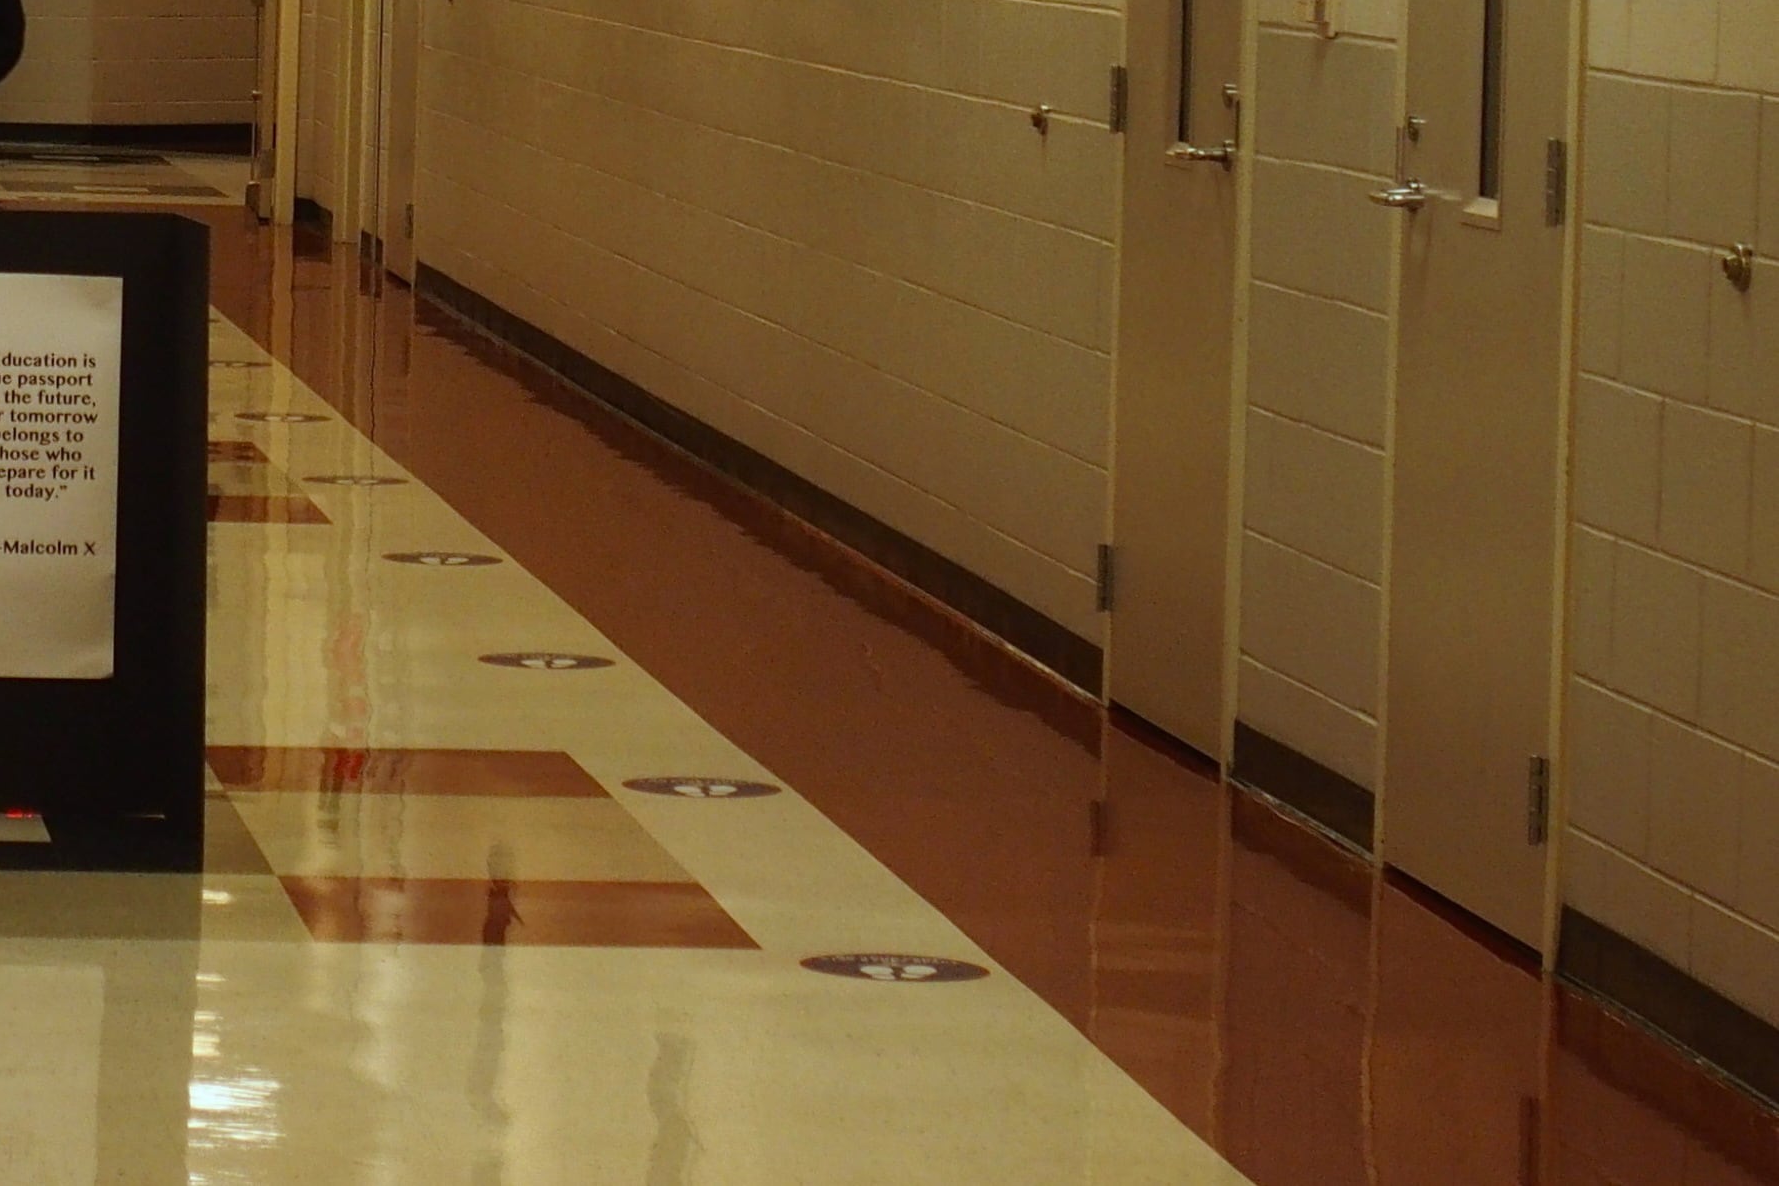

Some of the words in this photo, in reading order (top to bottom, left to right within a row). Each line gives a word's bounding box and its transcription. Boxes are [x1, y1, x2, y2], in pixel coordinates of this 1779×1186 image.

[83, 354, 96, 368] is
[18, 374, 93, 388] passport
[5, 390, 31, 404] the
[38, 390, 96, 407] future,
[10, 410, 98, 424] tomorrow
[66, 430, 84, 442] to
[46, 447, 82, 461] who
[52, 465, 78, 480] for
[84, 466, 96, 480] it
[83, 541, 96, 556] X
